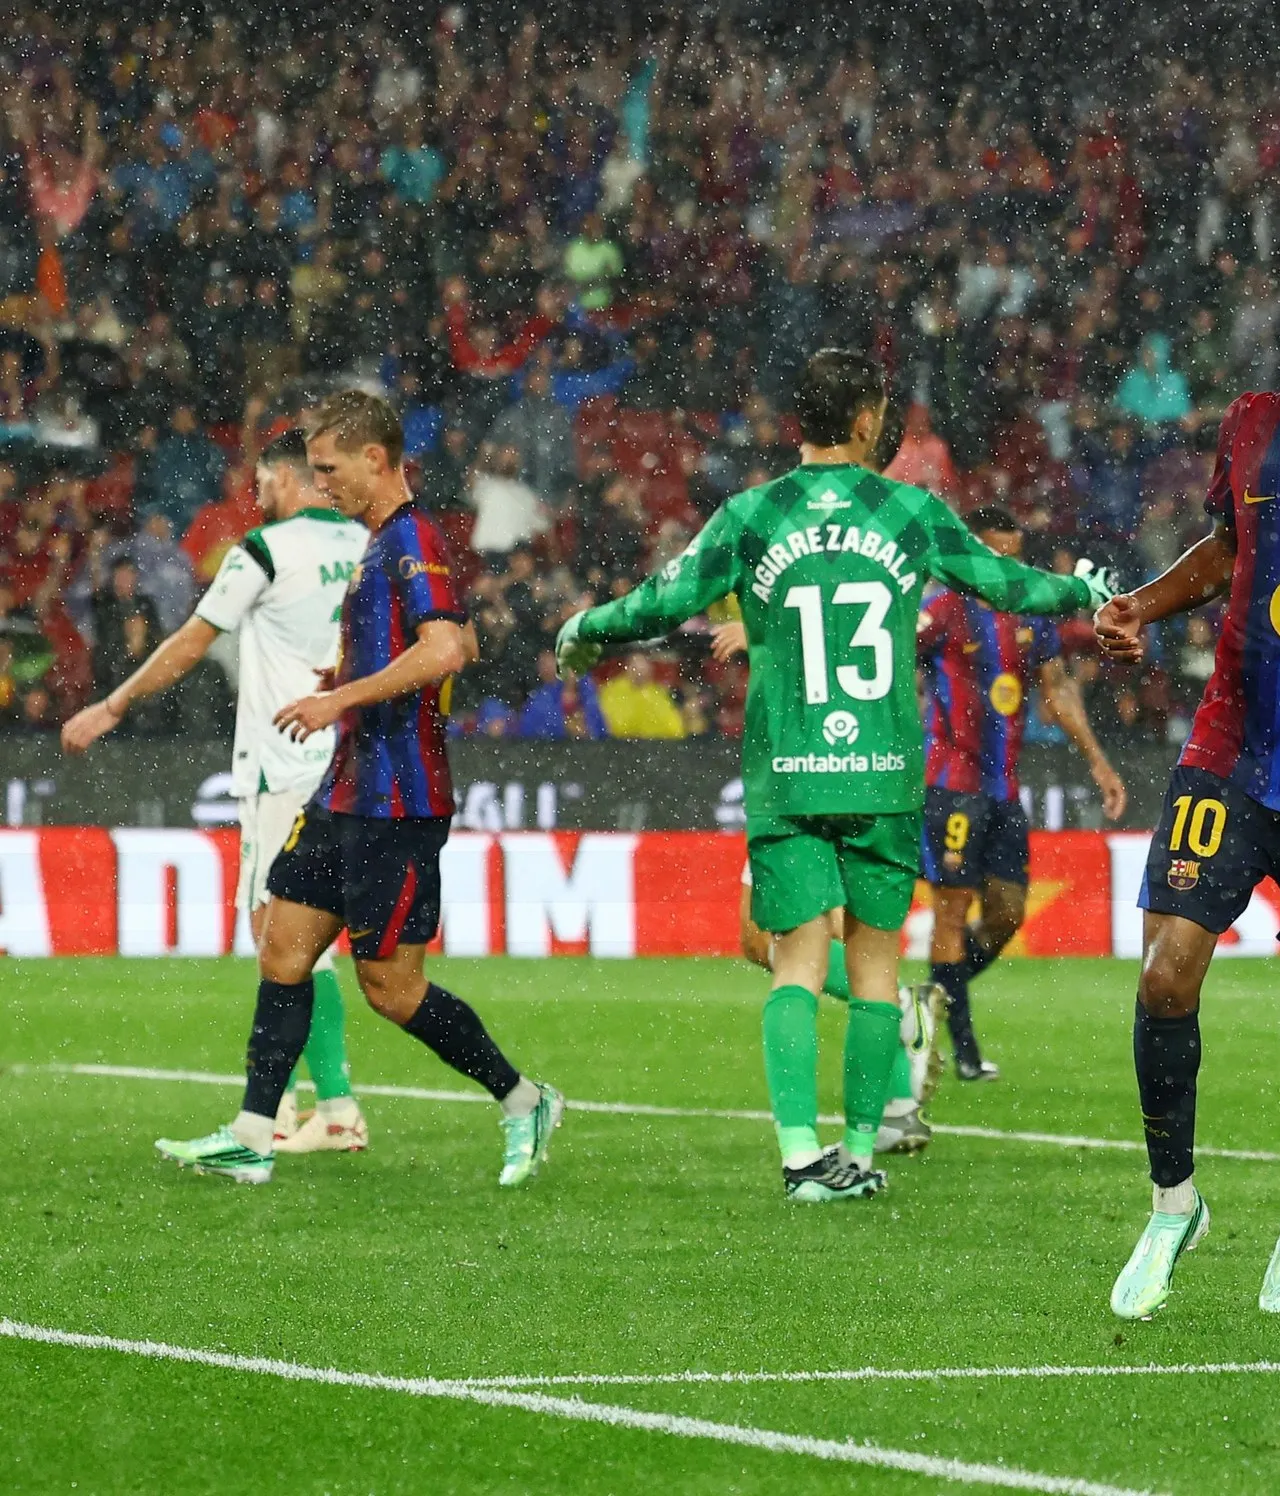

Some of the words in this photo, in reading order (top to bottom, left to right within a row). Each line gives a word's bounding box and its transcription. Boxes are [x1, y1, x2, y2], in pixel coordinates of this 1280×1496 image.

[751, 524, 917, 604] AGIRREZABALA
[783, 580, 894, 705] 13
[771, 752, 869, 774] cantabria
[871, 752, 906, 772] labs
[943, 811, 971, 851] 9
[1168, 795, 1228, 858] 10
